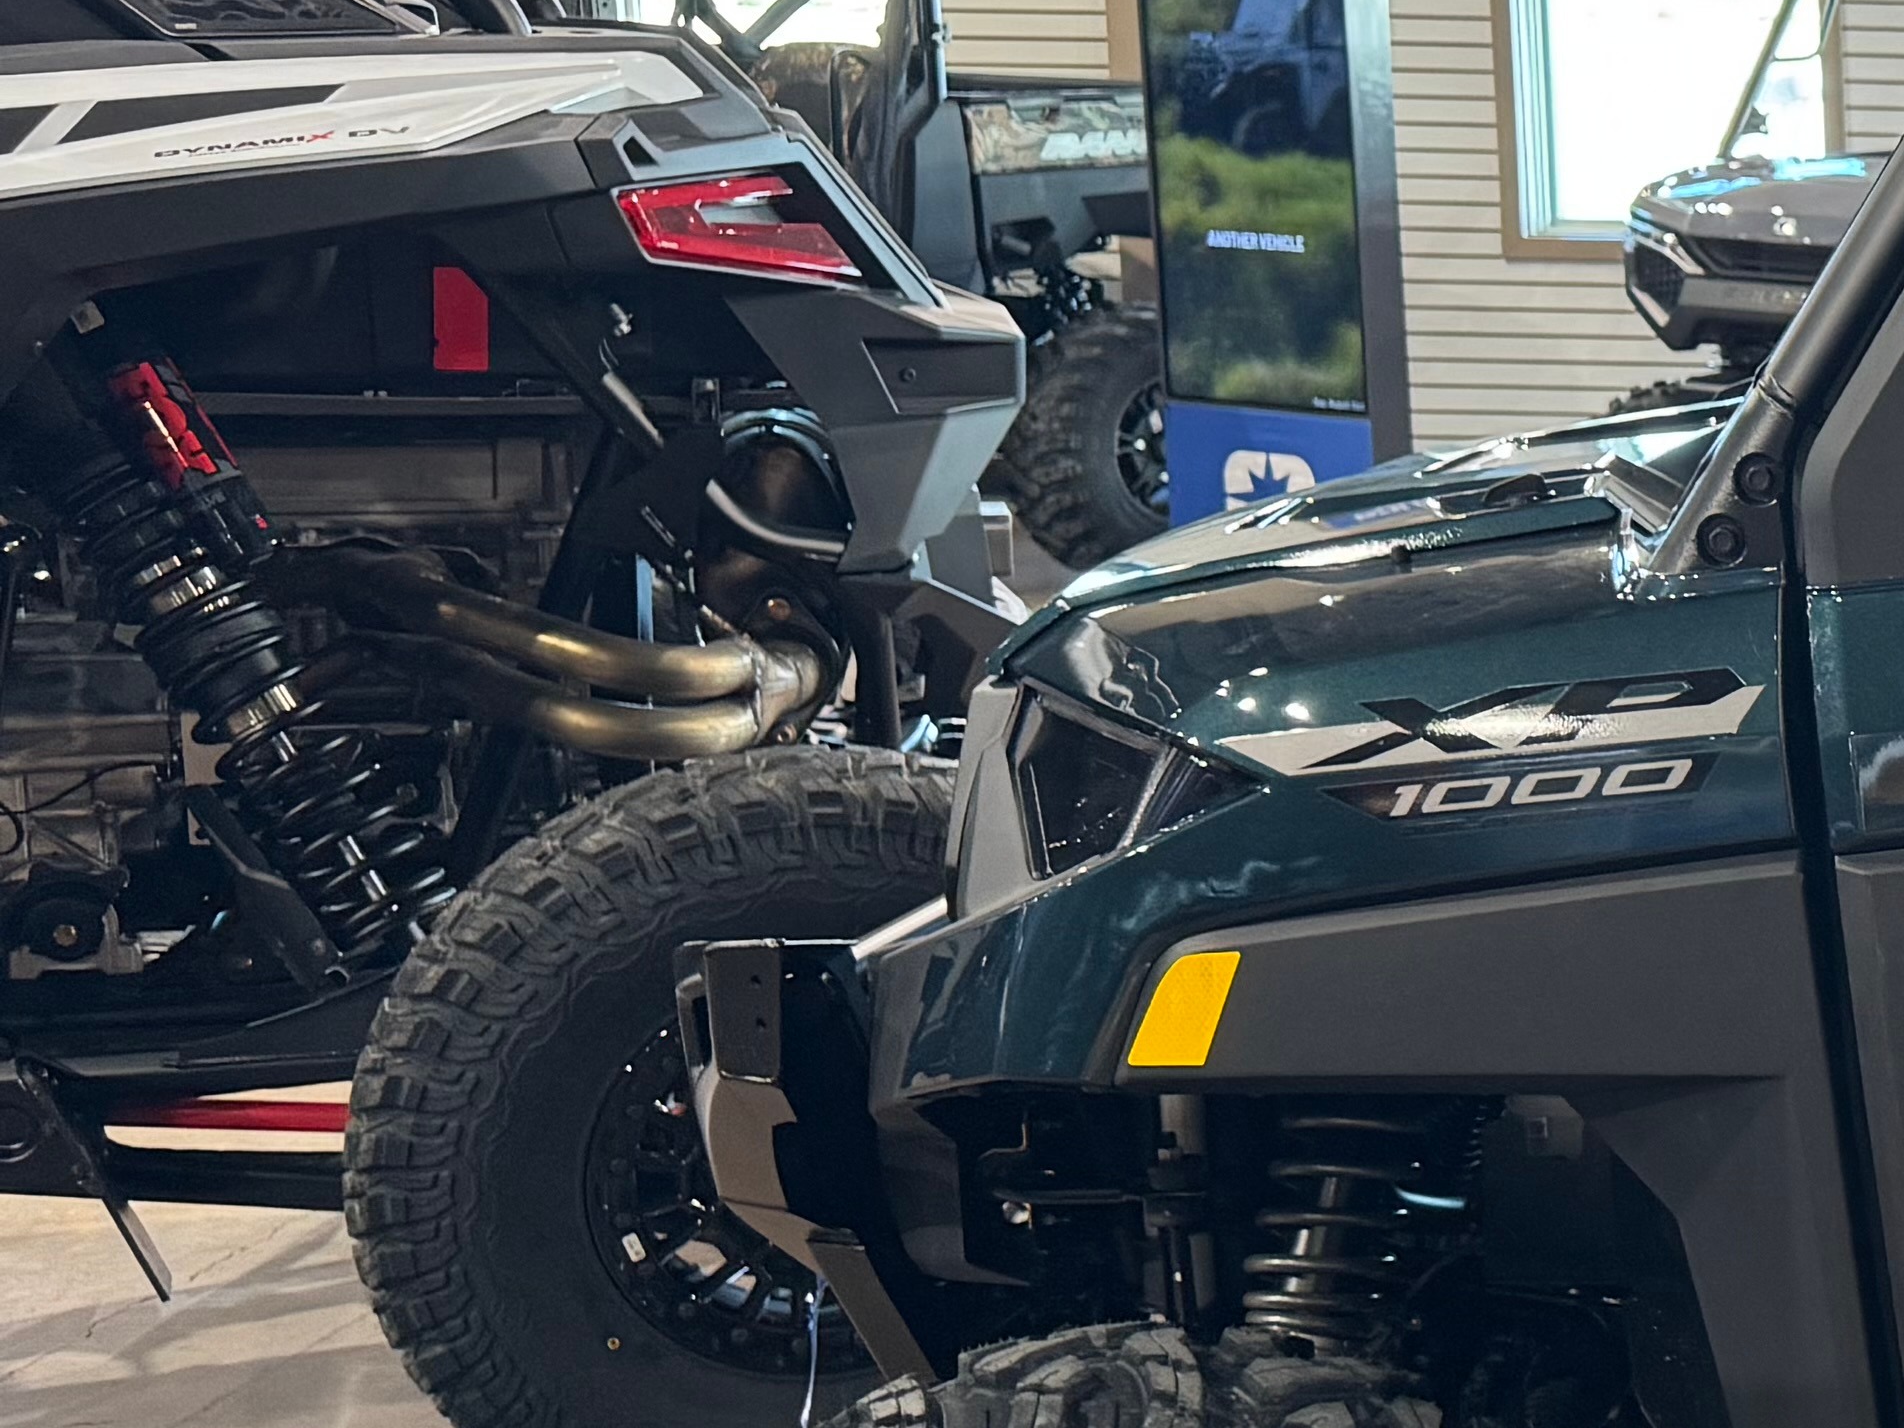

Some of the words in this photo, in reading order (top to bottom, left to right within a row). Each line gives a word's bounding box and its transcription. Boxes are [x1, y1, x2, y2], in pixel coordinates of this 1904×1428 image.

[154, 130, 334, 158] DYNAMIX
[1300, 665, 1748, 769] XP
[1389, 758, 1693, 818] 1000
